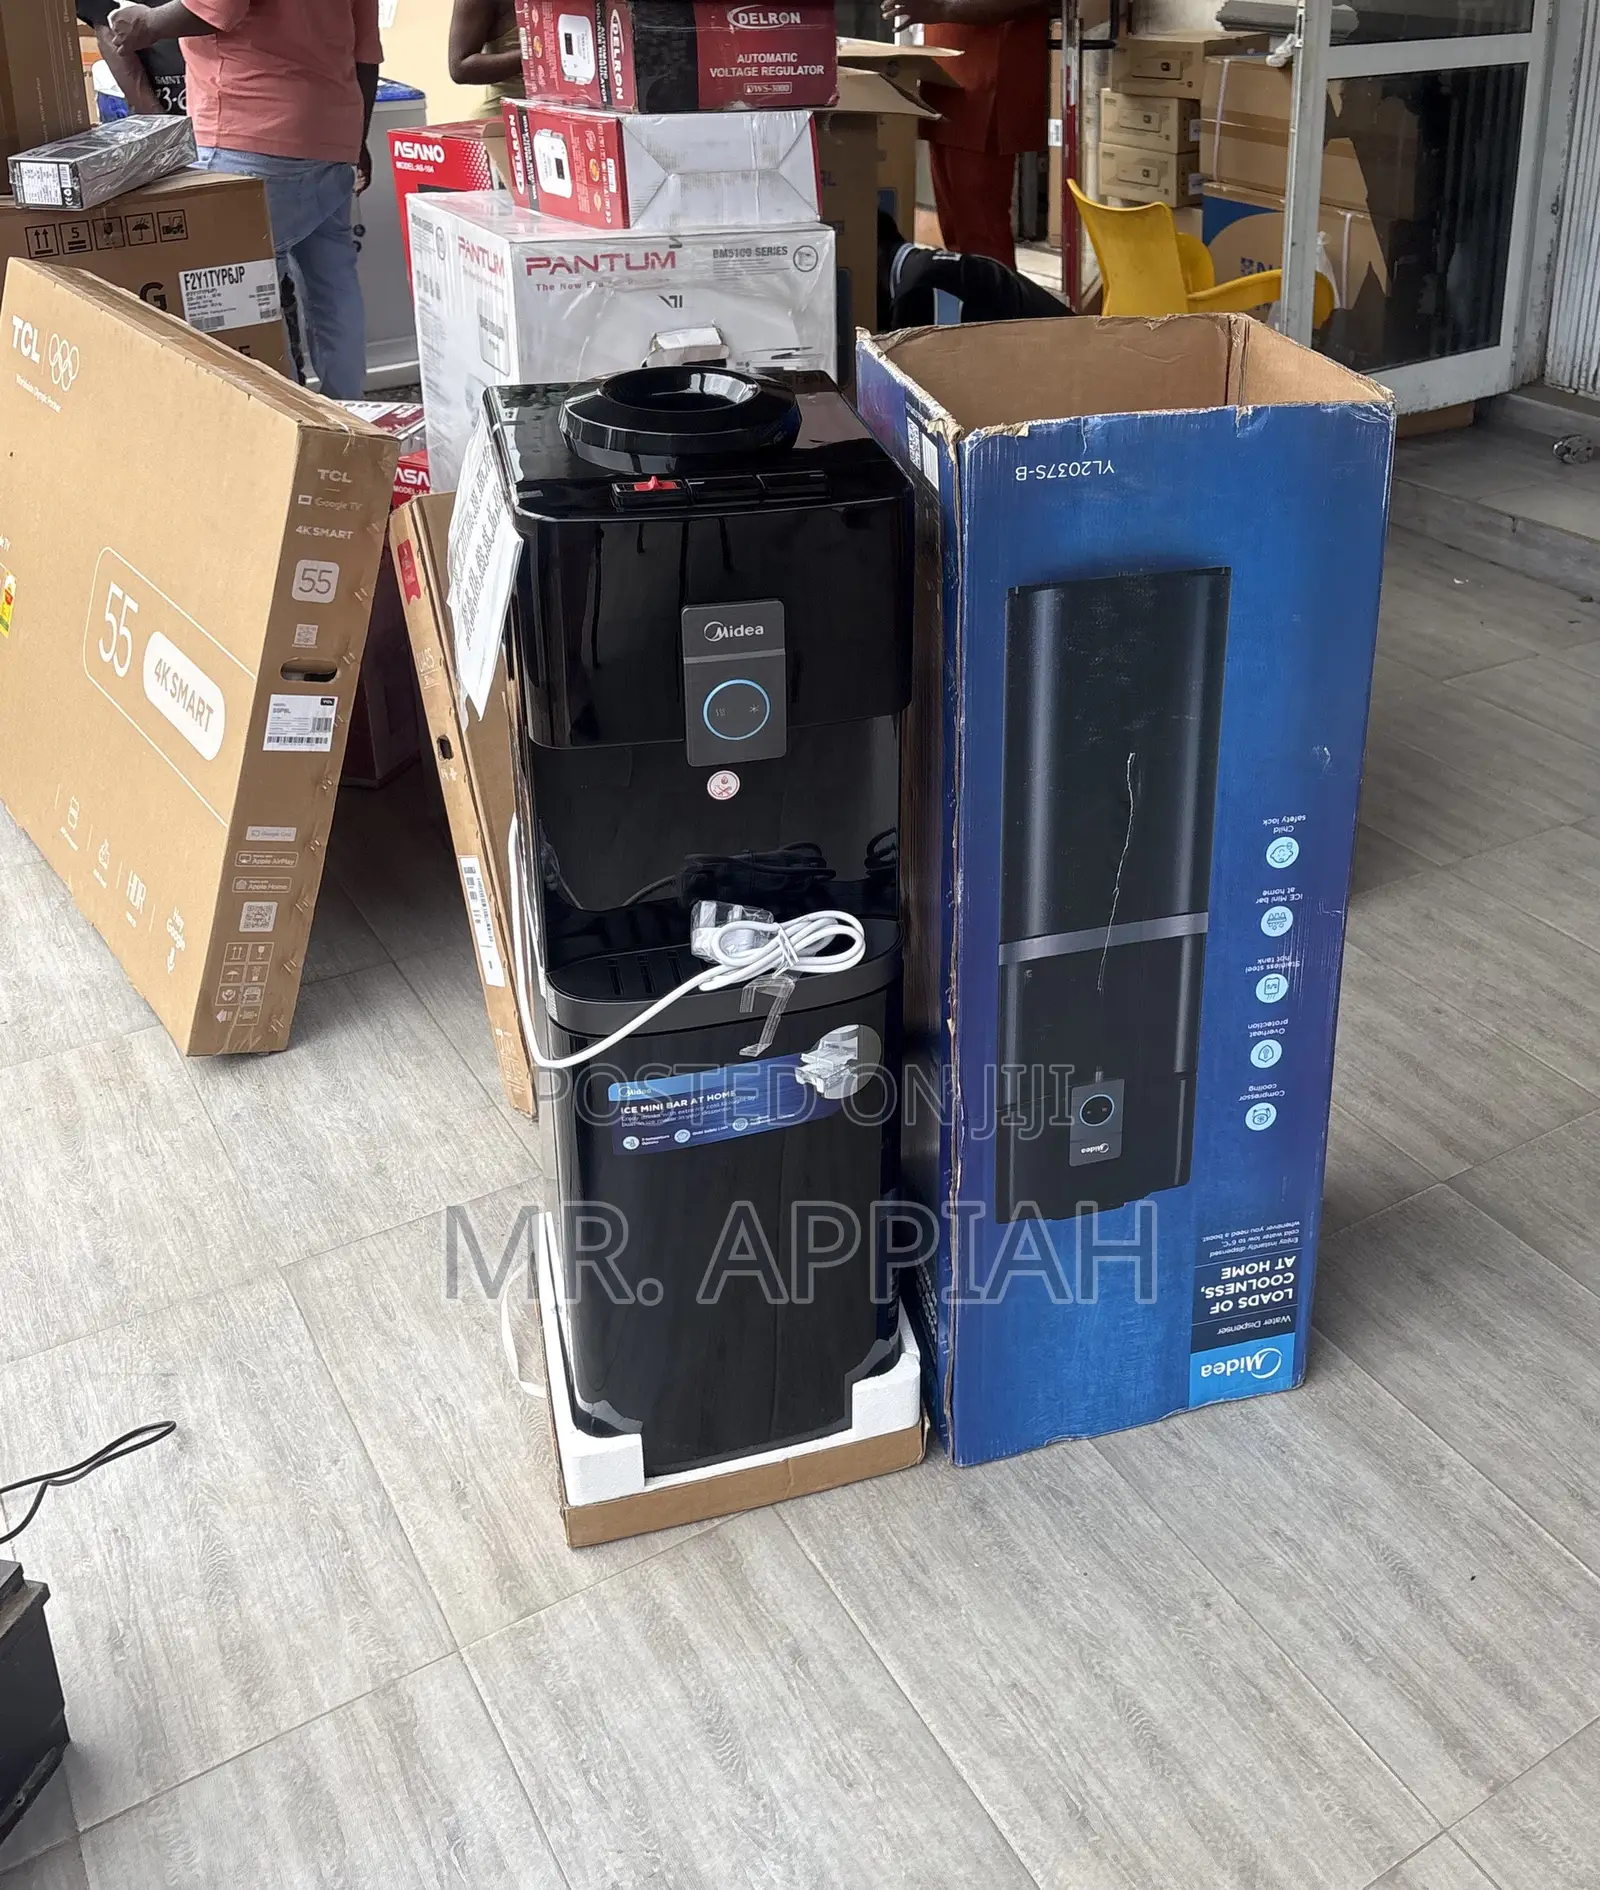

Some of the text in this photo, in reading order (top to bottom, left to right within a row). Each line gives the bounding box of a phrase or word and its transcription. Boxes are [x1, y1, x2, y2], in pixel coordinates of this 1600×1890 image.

[736, 11, 801, 26] DELRON
[611, 14, 624, 99] DELRON
[737, 53, 798, 63] AUTOMATIC
[710, 65, 824, 77] VOLTAGE REGULATOR
[154, 75, 181, 84] SAINT
[394, 141, 444, 163] ASANO
[458, 236, 505, 279] PANTUM
[756, 246, 788, 256] SERIES
[525, 251, 676, 276] PANTUM
[184, 266, 245, 291] F2Y1TYP6JP
[12, 315, 40, 364] TCL
[318, 469, 352, 483] TCL
[394, 467, 431, 487] ASA
[1016, 460, 1115, 481] YL2037S-B
[315, 497, 349, 510] Google
[298, 568, 333, 594] 55
[99, 581, 138, 678] 55
[704, 621, 764, 641] Midea
[1263, 815, 1306, 826] safety lock
[1273, 826, 1294, 834] Child
[1256, 893, 1303, 904] ICE Mini bar
[1262, 888, 1284, 896] home
[1245, 965, 1264, 974] steel
[1248, 1018, 1289, 1029] protection
[1250, 1028, 1285, 1037] Overheat
[1249, 1083, 1277, 1091] cooling
[621, 1090, 737, 1114] ICE MINI BAR AT HOME
[1239, 1090, 1285, 1101] Compressor
[1081, 1143, 1109, 1153] Midea
[1231, 1229, 1249, 1237] need
[1250, 1225, 1264, 1234] you
[1262, 1231, 1282, 1241] water
[1284, 1229, 1299, 1238] cold
[1279, 1237, 1299, 1248] Enjoy
[1209, 1245, 1246, 1258] dispensed
[1221, 1255, 1296, 1279] AT HOME
[1201, 1272, 1295, 1299] COOLNESS,
[1209, 1288, 1293, 1315] LOADS OF
[1217, 1315, 1291, 1335] Water Dispenser
[1201, 1348, 1283, 1379] Midea
